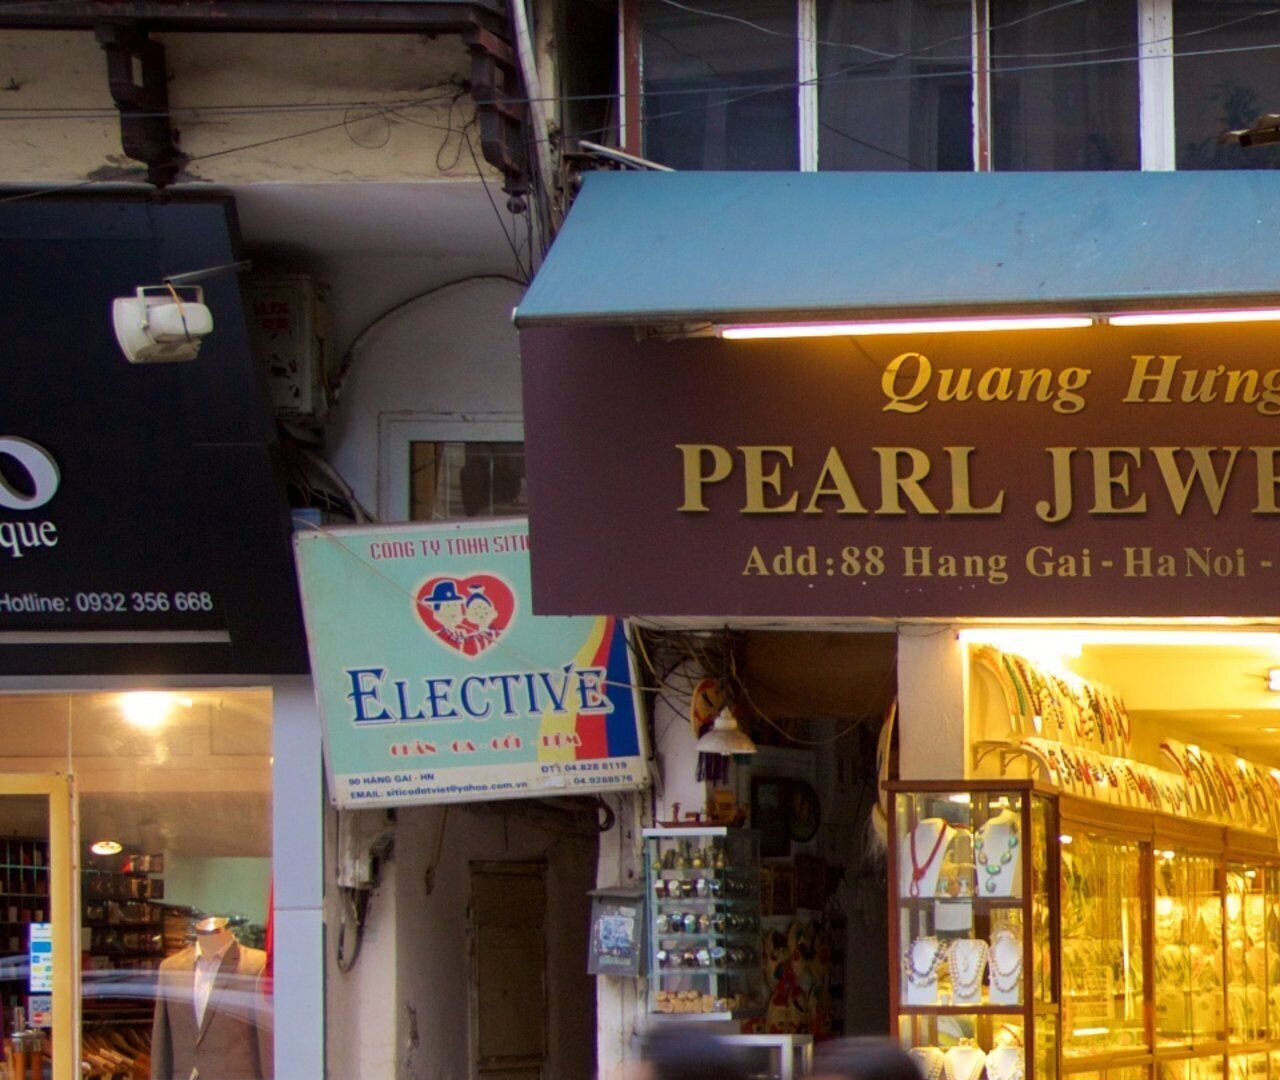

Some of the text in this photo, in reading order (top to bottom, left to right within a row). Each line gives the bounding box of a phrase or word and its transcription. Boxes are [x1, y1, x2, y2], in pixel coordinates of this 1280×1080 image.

[881, 352, 1091, 414] Quang
[675, 444, 1005, 516] PEARL
[420, 540, 441, 556] TY
[446, 537, 489, 555] TNHH
[903, 545, 1009, 585] Hang
[1025, 545, 1093, 577] Gai
[76, 592, 127, 612] 0932
[132, 592, 170, 612] 356
[175, 591, 213, 612] 668
[394, 773, 412, 783] GAI
[420, 772, 435, 781] HN
